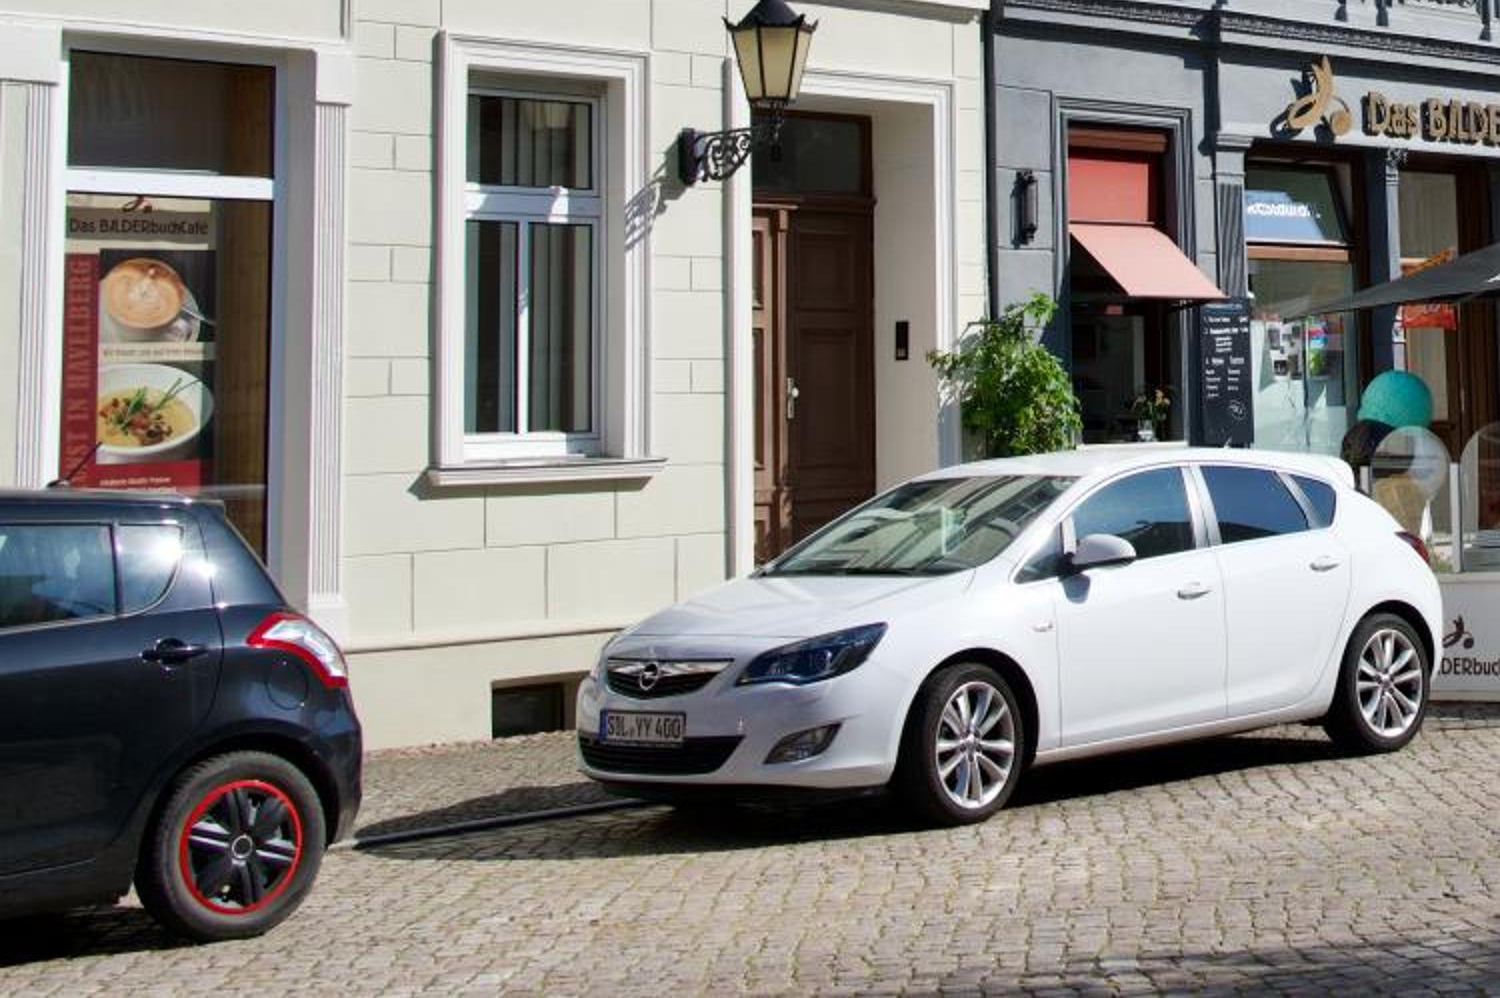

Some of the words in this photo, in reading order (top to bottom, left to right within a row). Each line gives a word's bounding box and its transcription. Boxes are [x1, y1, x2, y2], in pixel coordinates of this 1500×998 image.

[1366, 91, 1418, 134] Das
[69, 217, 97, 233] Das
[66, 259, 92, 389] HAVELBERG
